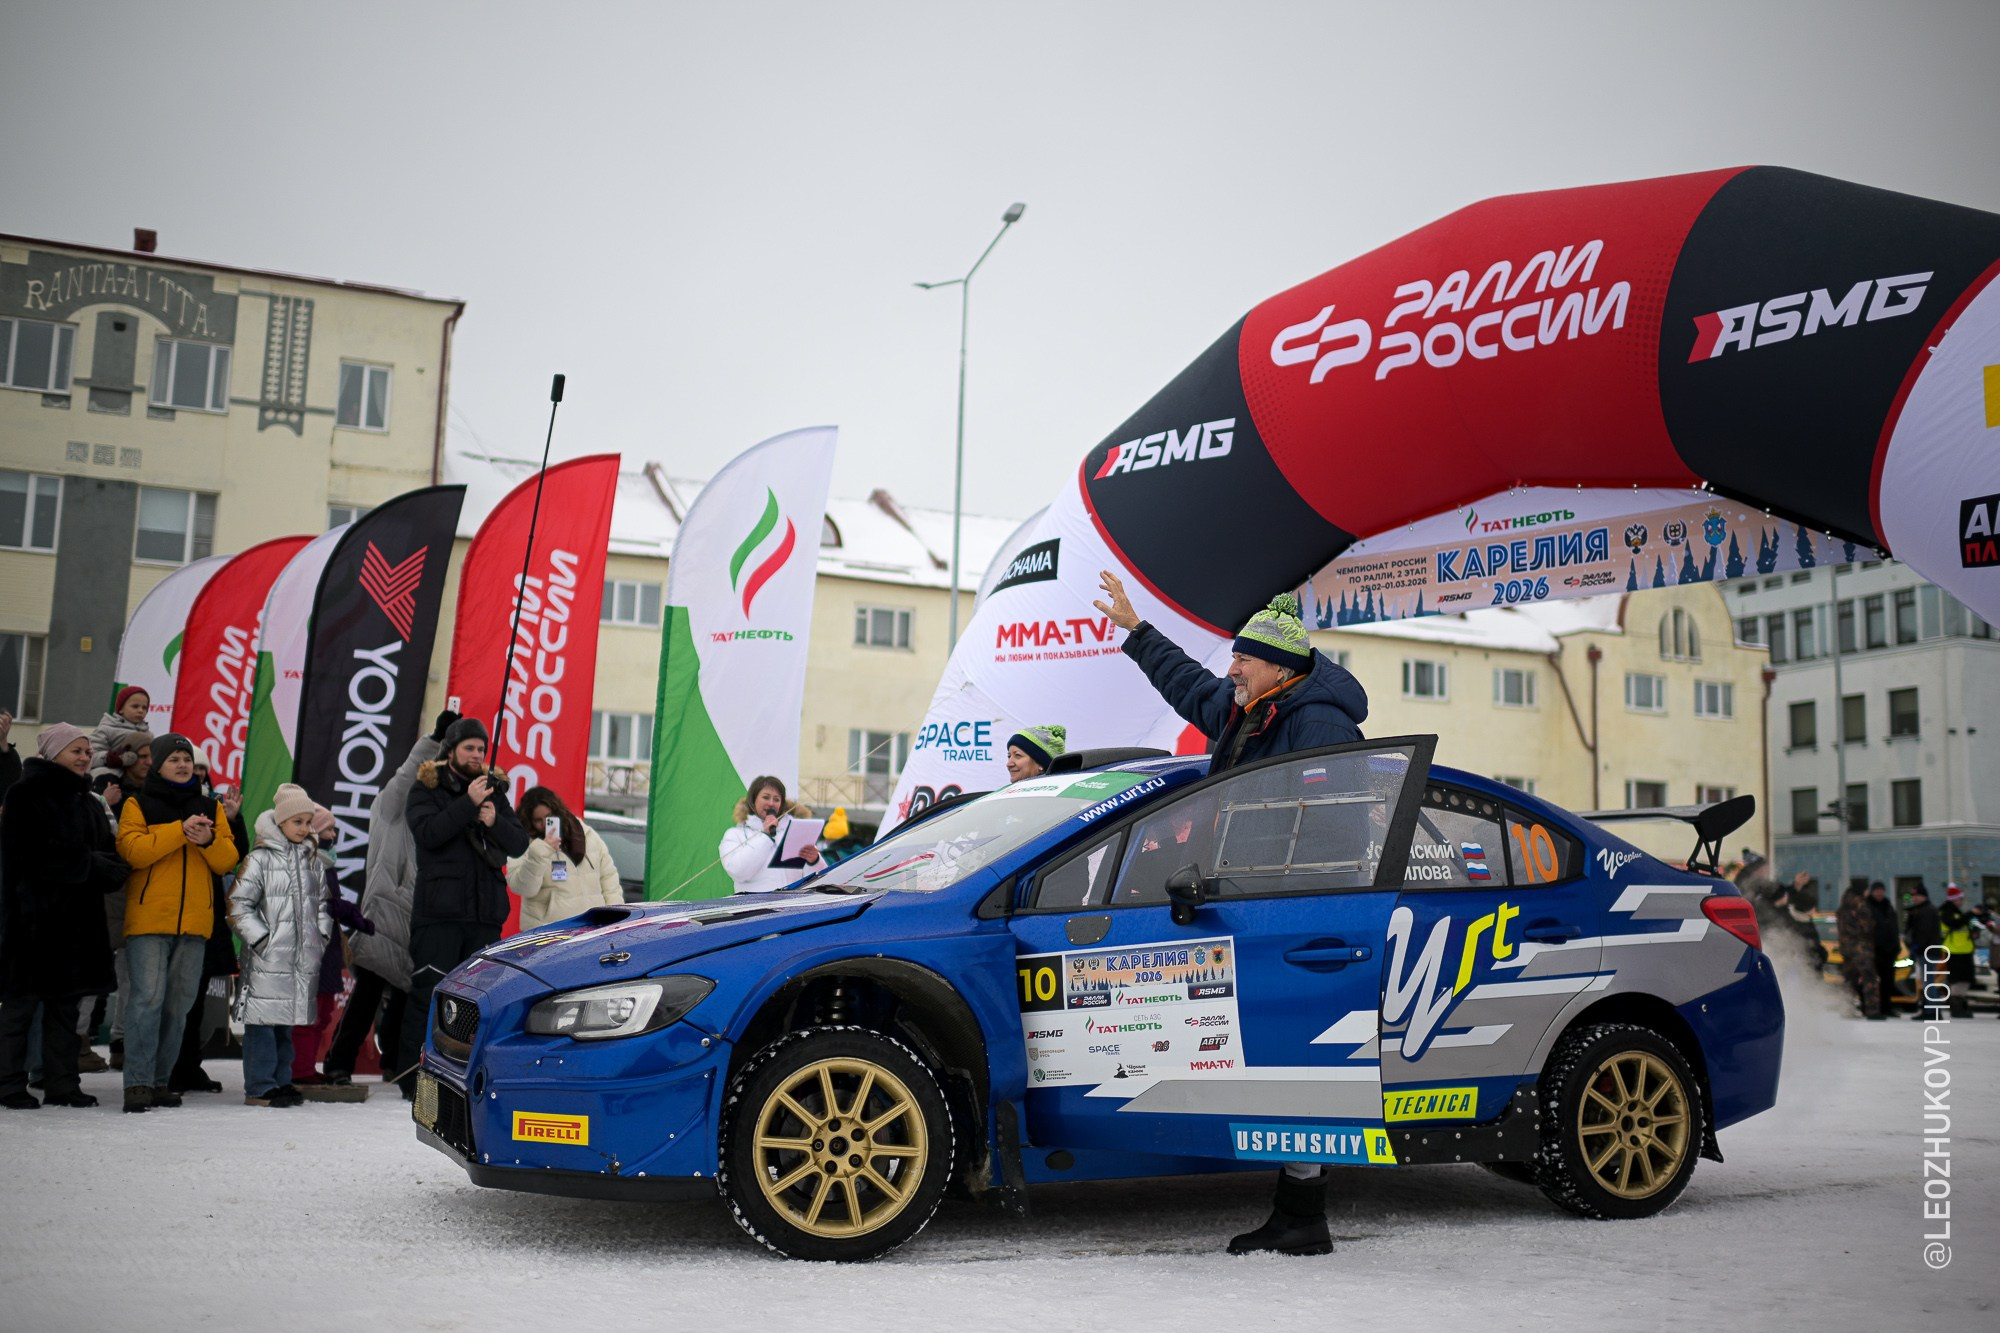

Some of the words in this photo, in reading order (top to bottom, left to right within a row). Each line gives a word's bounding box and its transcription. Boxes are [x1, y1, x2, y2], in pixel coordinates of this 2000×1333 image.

[1384, 239, 1604, 327] РАЛЛИ
[1688, 271, 1935, 363] ASMG
[1375, 281, 1631, 381] РОССИИ
[1093, 417, 1236, 480] ASMG
[1481, 509, 1575, 532] ТАТНЕФТЬ
[1336, 561, 1388, 576] ЧЕМПИОНАТ
[1391, 556, 1427, 569] РОССИИ
[1436, 527, 1610, 585] КАРЕЛИЯ
[1349, 574, 1362, 585] ПО
[1364, 570, 1396, 582] РАЛЛИ,
[1404, 566, 1427, 576] ЭТАП
[1437, 591, 1473, 603] ASMG
[1492, 576, 1550, 605] 2026
[711, 629, 794, 643] ТАТНЕФТЬ
[493, 573, 543, 755] РАЛЛИ
[529, 549, 579, 767] РОССИИ
[995, 655, 1006, 663] МЫ
[1008, 653, 1034, 662] ЛЮБИМ
[1036, 652, 1041, 661] И
[1043, 649, 1100, 661] ПОКАЗЫВАЕМ
[200, 625, 248, 777] РАЛЛИ
[914, 721, 993, 751] SPACE
[943, 749, 993, 761] TRAVEL
[1078, 776, 1166, 823] www.urt.ru
[1511, 823, 1559, 883] 10
[1106, 949, 1189, 972] КАРЕЛИЯ
[1019, 966, 1057, 1002] 10
[1134, 970, 1163, 983] 2026
[1125, 994, 1182, 1005] ТАТНЕФТЬ
[1195, 986, 1226, 996] ASMG
[1027, 1029, 1064, 1040] ASMG
[1096, 1022, 1163, 1034] ТАТНЕФТЬ
[1088, 1044, 1121, 1054] SPACE
[1201, 1037, 1227, 1046] АВТО
[1190, 1059, 1234, 1071] MMA-TV!
[1393, 1094, 1470, 1116] TECNICA
[518, 1118, 581, 1141] PIRELLI
[1236, 1131, 1361, 1156] USPENSKIY
